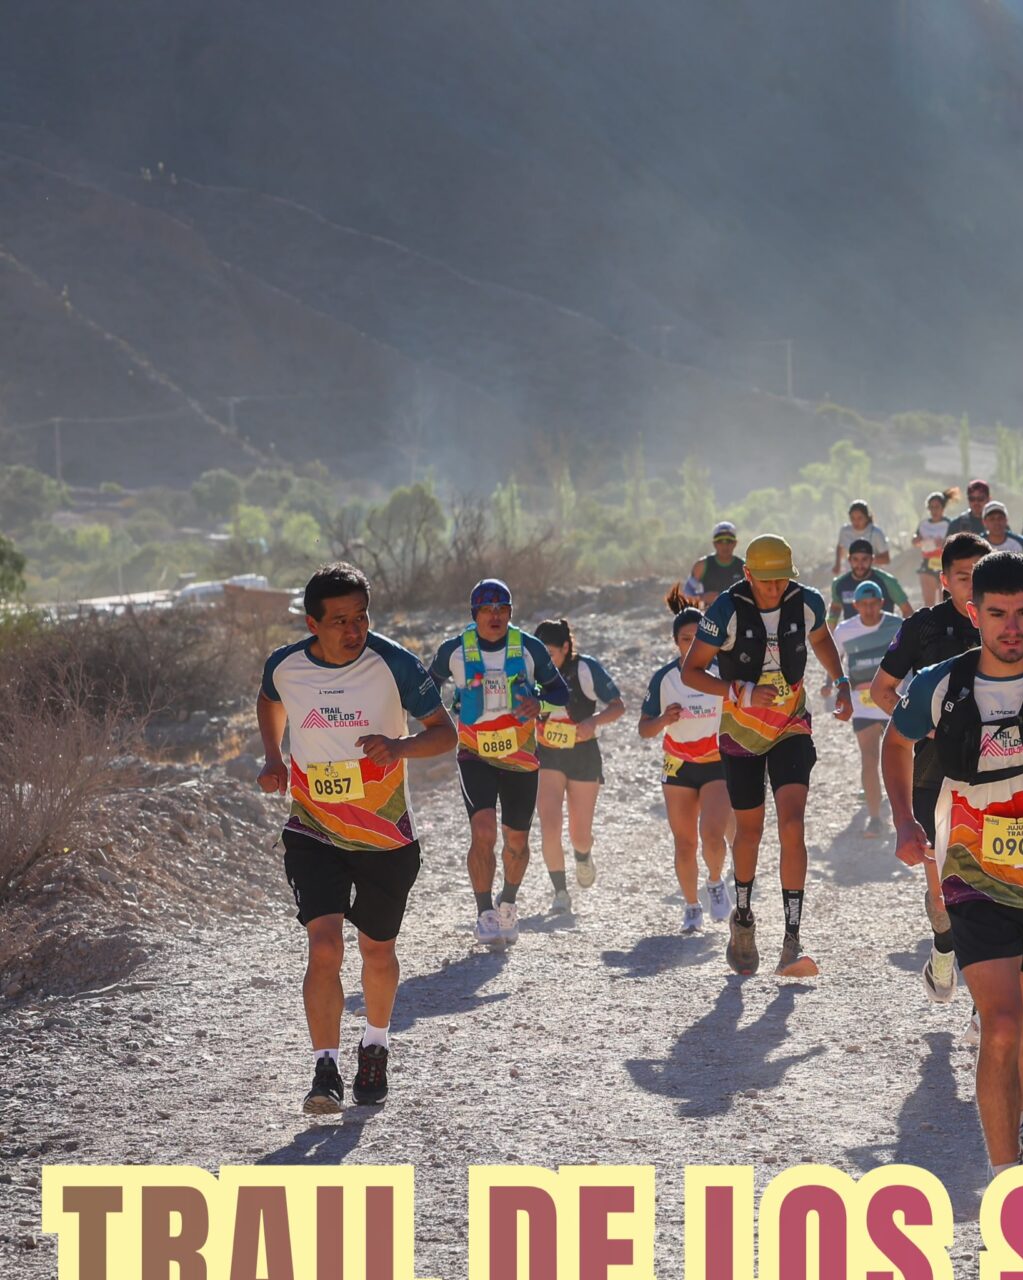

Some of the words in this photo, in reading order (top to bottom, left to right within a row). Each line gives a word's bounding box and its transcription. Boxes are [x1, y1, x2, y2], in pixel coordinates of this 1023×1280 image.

[355, 711, 362, 720] 7
[334, 720, 369, 728] COLORES
[546, 731, 568, 743] 0773
[483, 739, 512, 753] 0888
[314, 777, 351, 795] 0857
